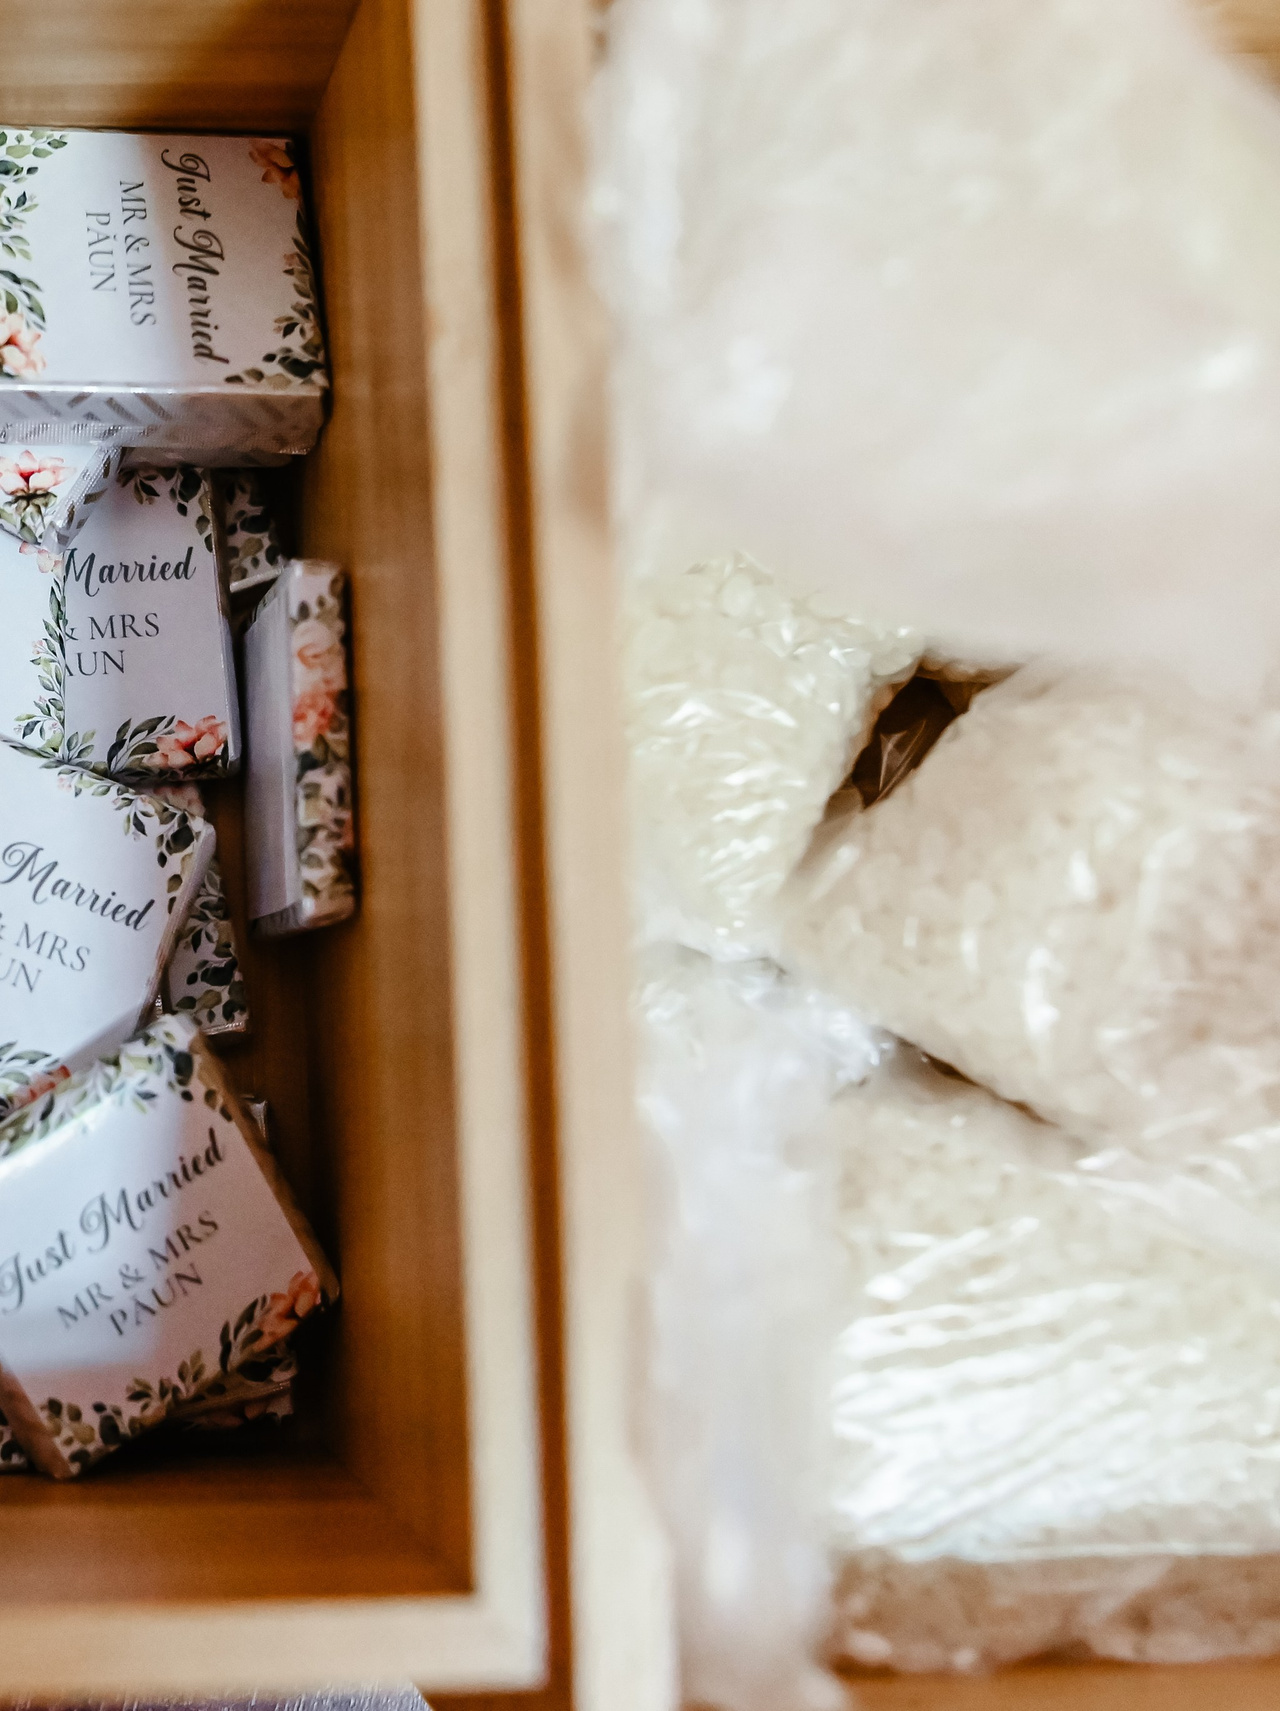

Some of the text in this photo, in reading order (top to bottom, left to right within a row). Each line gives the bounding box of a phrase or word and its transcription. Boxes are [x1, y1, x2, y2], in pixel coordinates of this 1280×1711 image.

[119, 180, 157, 328] MR & MRS
[161, 149, 230, 365] Just Married
[89, 612, 161, 641] MRS
[15, 922, 91, 972] MRS
[79, 1127, 226, 1253] Married
[54, 1209, 220, 1332] MR & MRS
